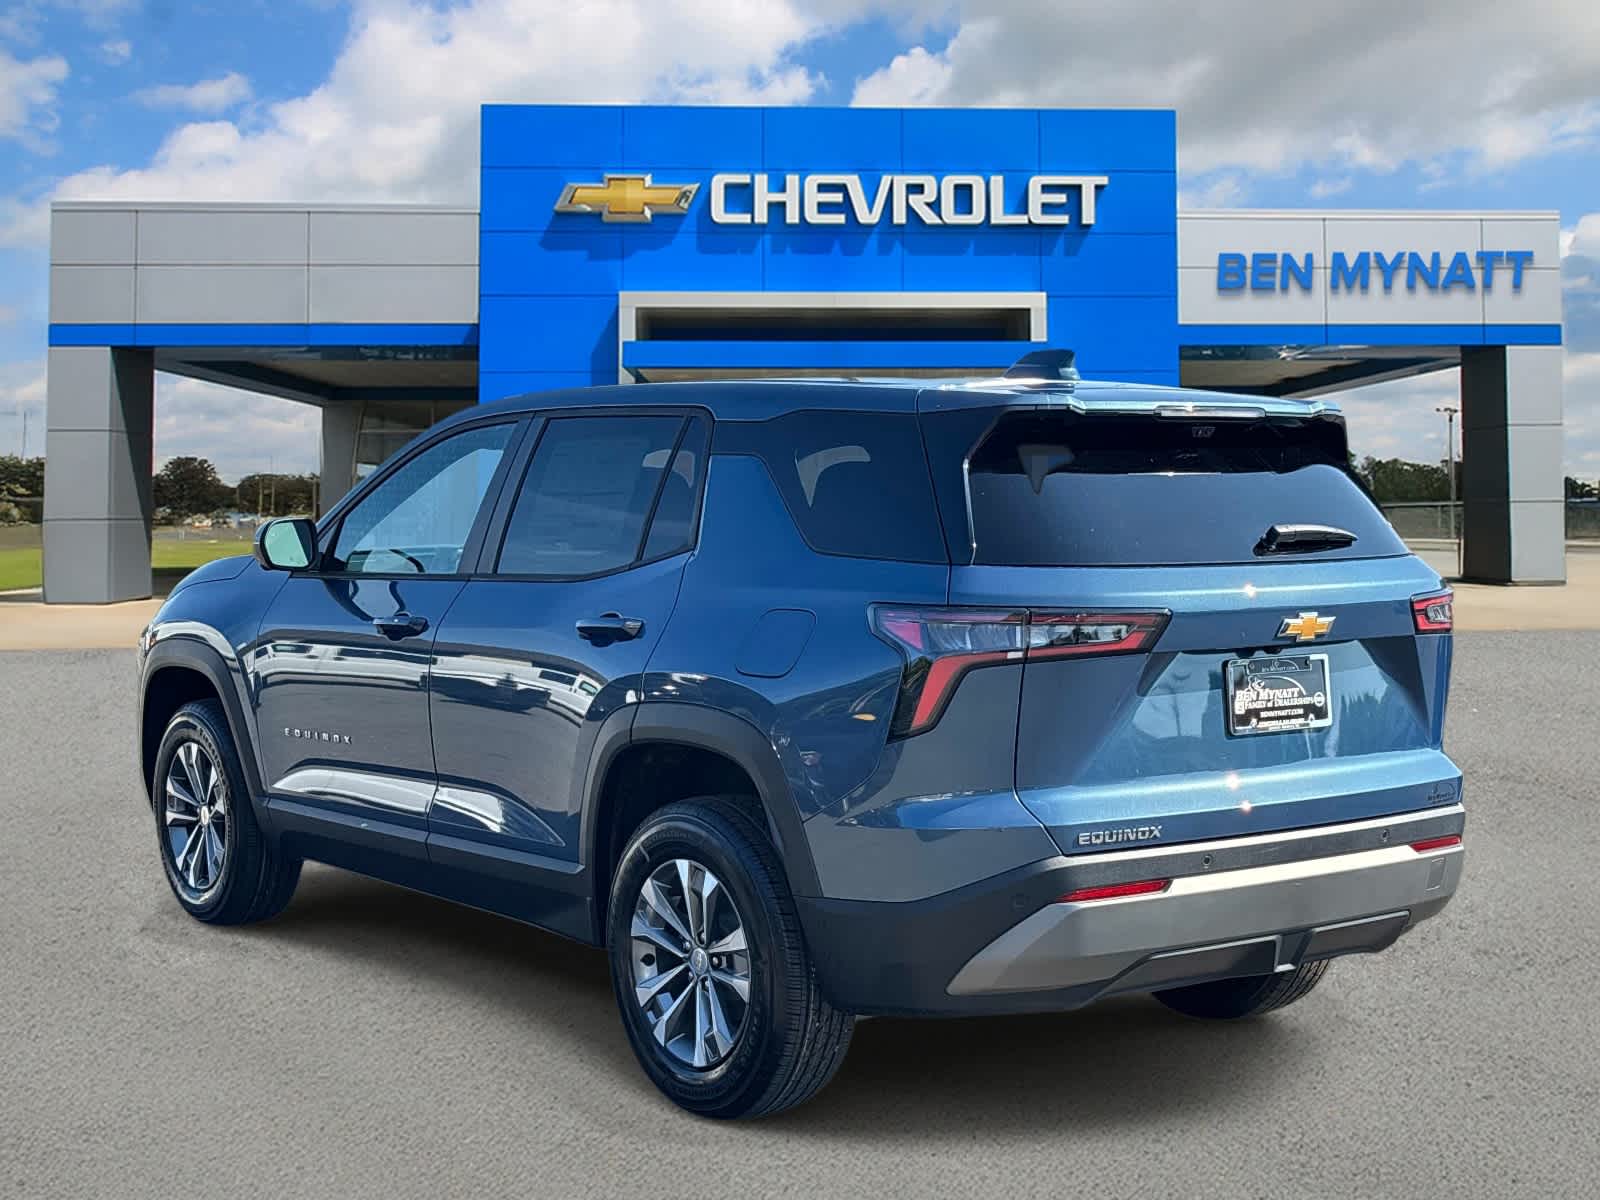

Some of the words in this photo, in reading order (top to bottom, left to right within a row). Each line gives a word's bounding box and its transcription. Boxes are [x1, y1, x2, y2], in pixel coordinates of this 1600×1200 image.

[710, 173, 1109, 225] CHEVROLET
[1217, 252, 1313, 292] BEN
[1330, 250, 1534, 290] MYNATT
[1236, 690, 1257, 701] BEN
[1259, 688, 1299, 700] MYNATT
[284, 727, 351, 744] EQUINOX
[1078, 825, 1163, 845] EQUINOX
